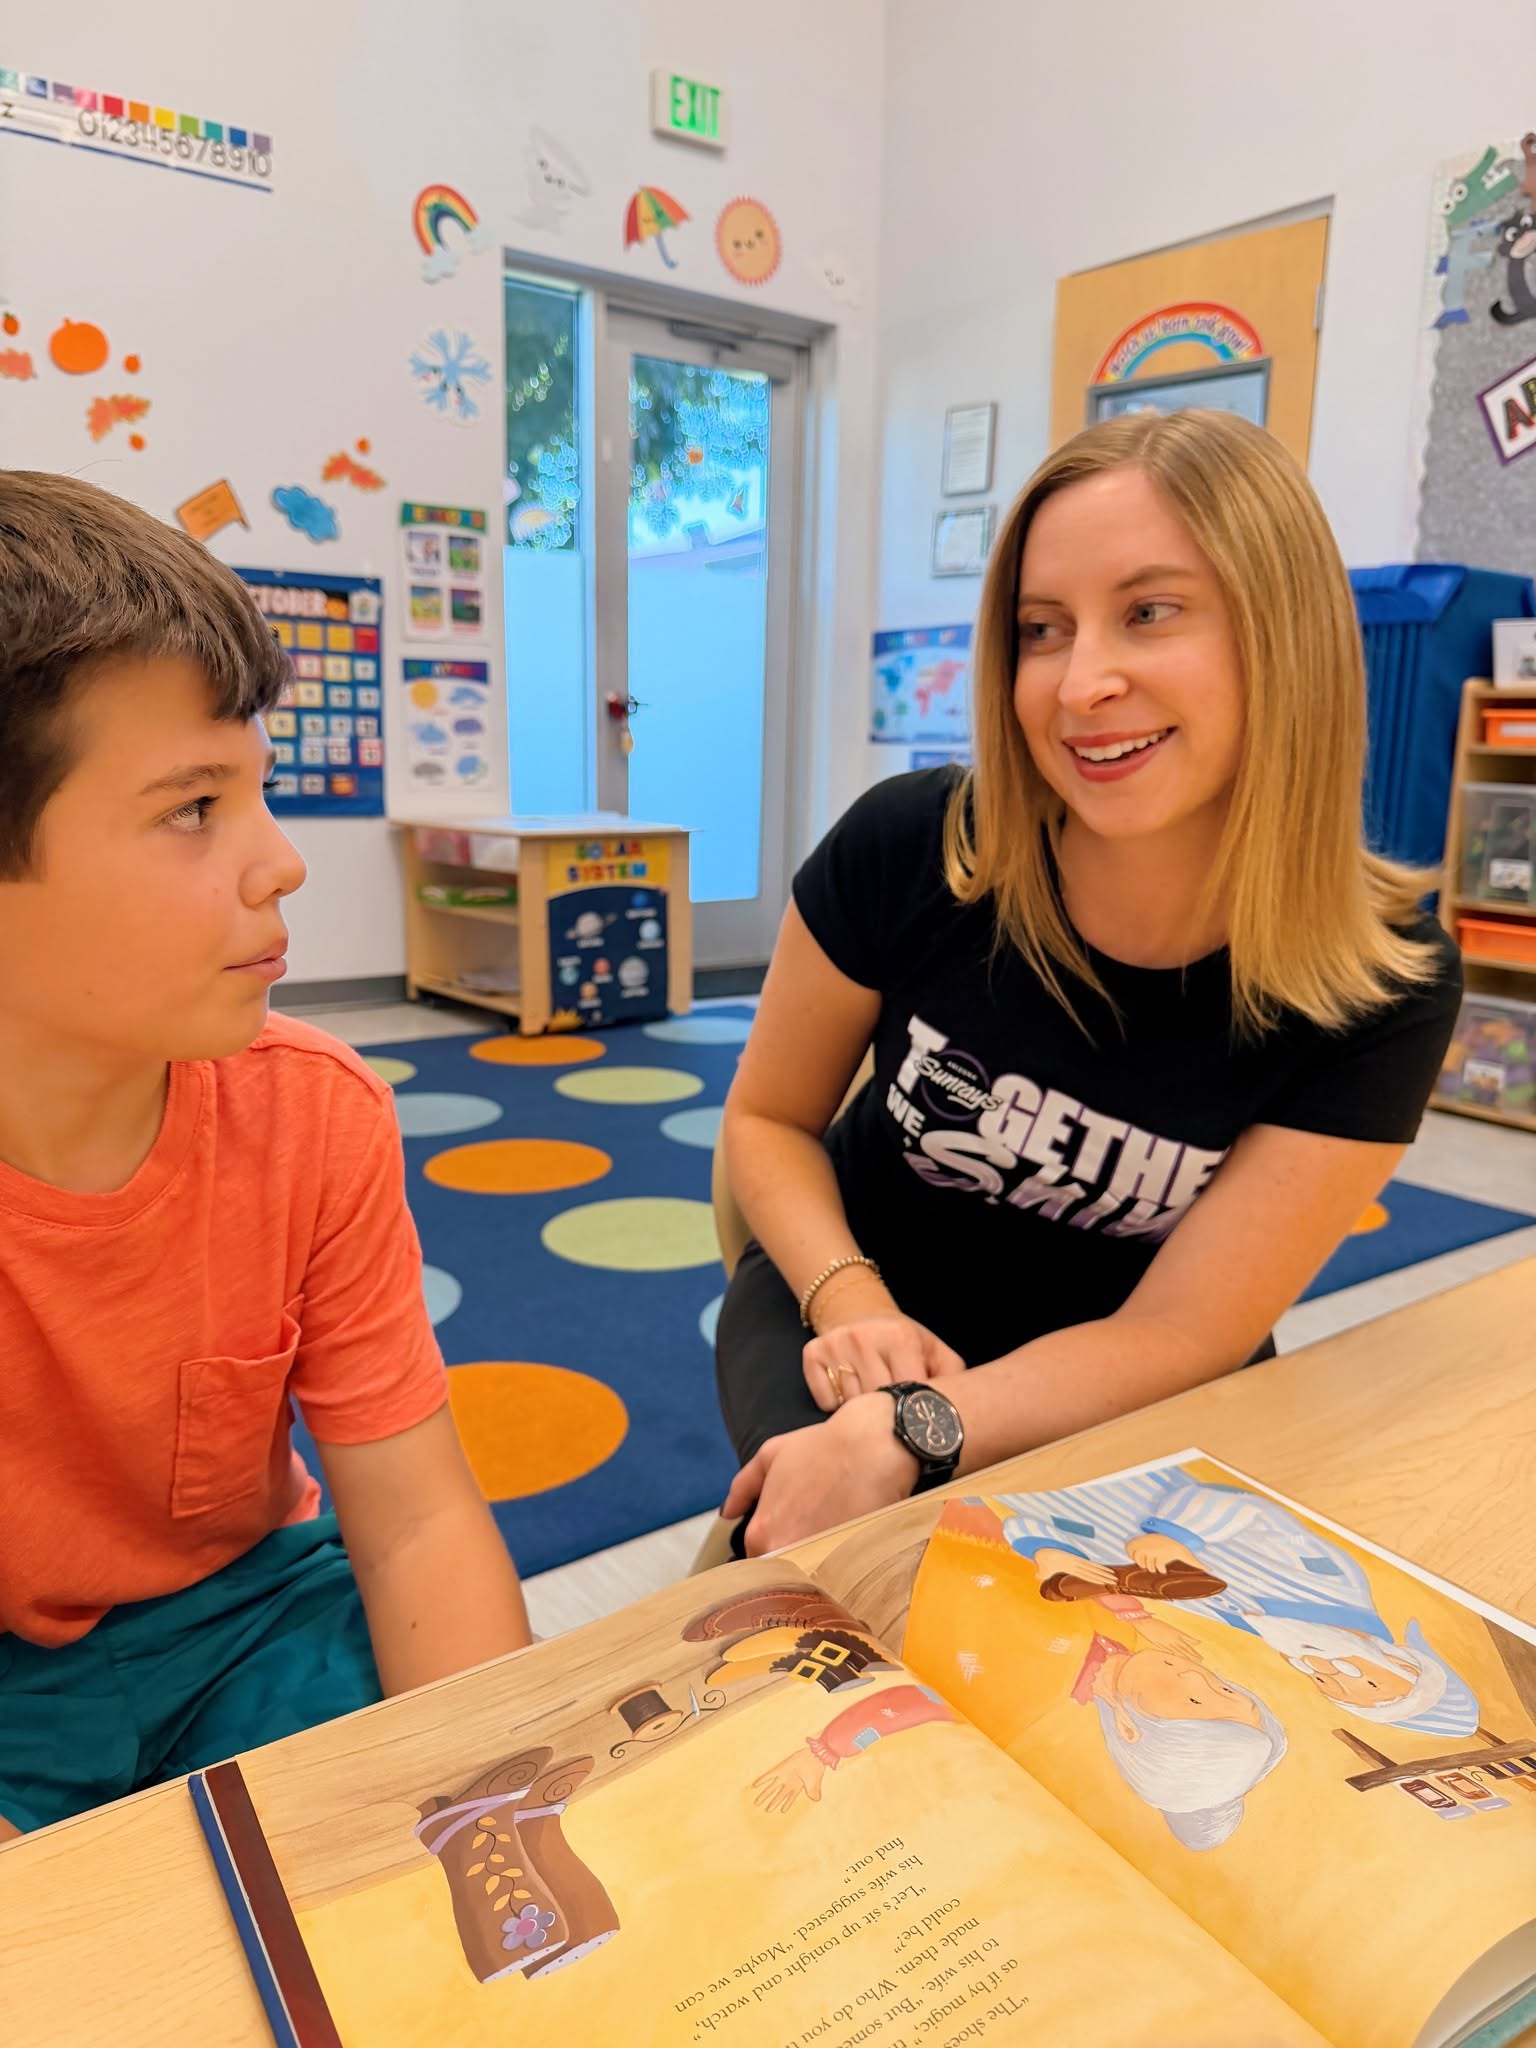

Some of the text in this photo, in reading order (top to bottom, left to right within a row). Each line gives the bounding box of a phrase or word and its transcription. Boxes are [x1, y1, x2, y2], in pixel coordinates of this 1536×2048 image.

[670, 75, 721, 140] EXIT
[576, 839, 643, 861] SOLAR
[567, 862, 648, 882] SYSTEM
[914, 1055, 1003, 1112] Sunrays
[886, 1083, 926, 1139] WE
[875, 1838, 904, 1860] find
[899, 1855, 923, 1870] his
[868, 1870, 897, 1890] wife
[793, 1889, 866, 1941] suggested.
[862, 1909, 881, 1924] sit
[921, 1899, 960, 1931] could
[842, 1923, 861, 1937] up
[982, 1938, 999, 1951] to
[784, 1937, 840, 1976] tonight
[958, 1950, 984, 1968] his
[1001, 1960, 1017, 1973] as
[708, 1978, 730, 1992] we
[752, 1975, 782, 2001] and
[802, 1918, 979, 2042] made them. Who do you
[922, 1968, 957, 1992] wife.
[989, 1972, 1003, 1990] if
[968, 1981, 991, 2001] by
[675, 1992, 704, 2012] can
